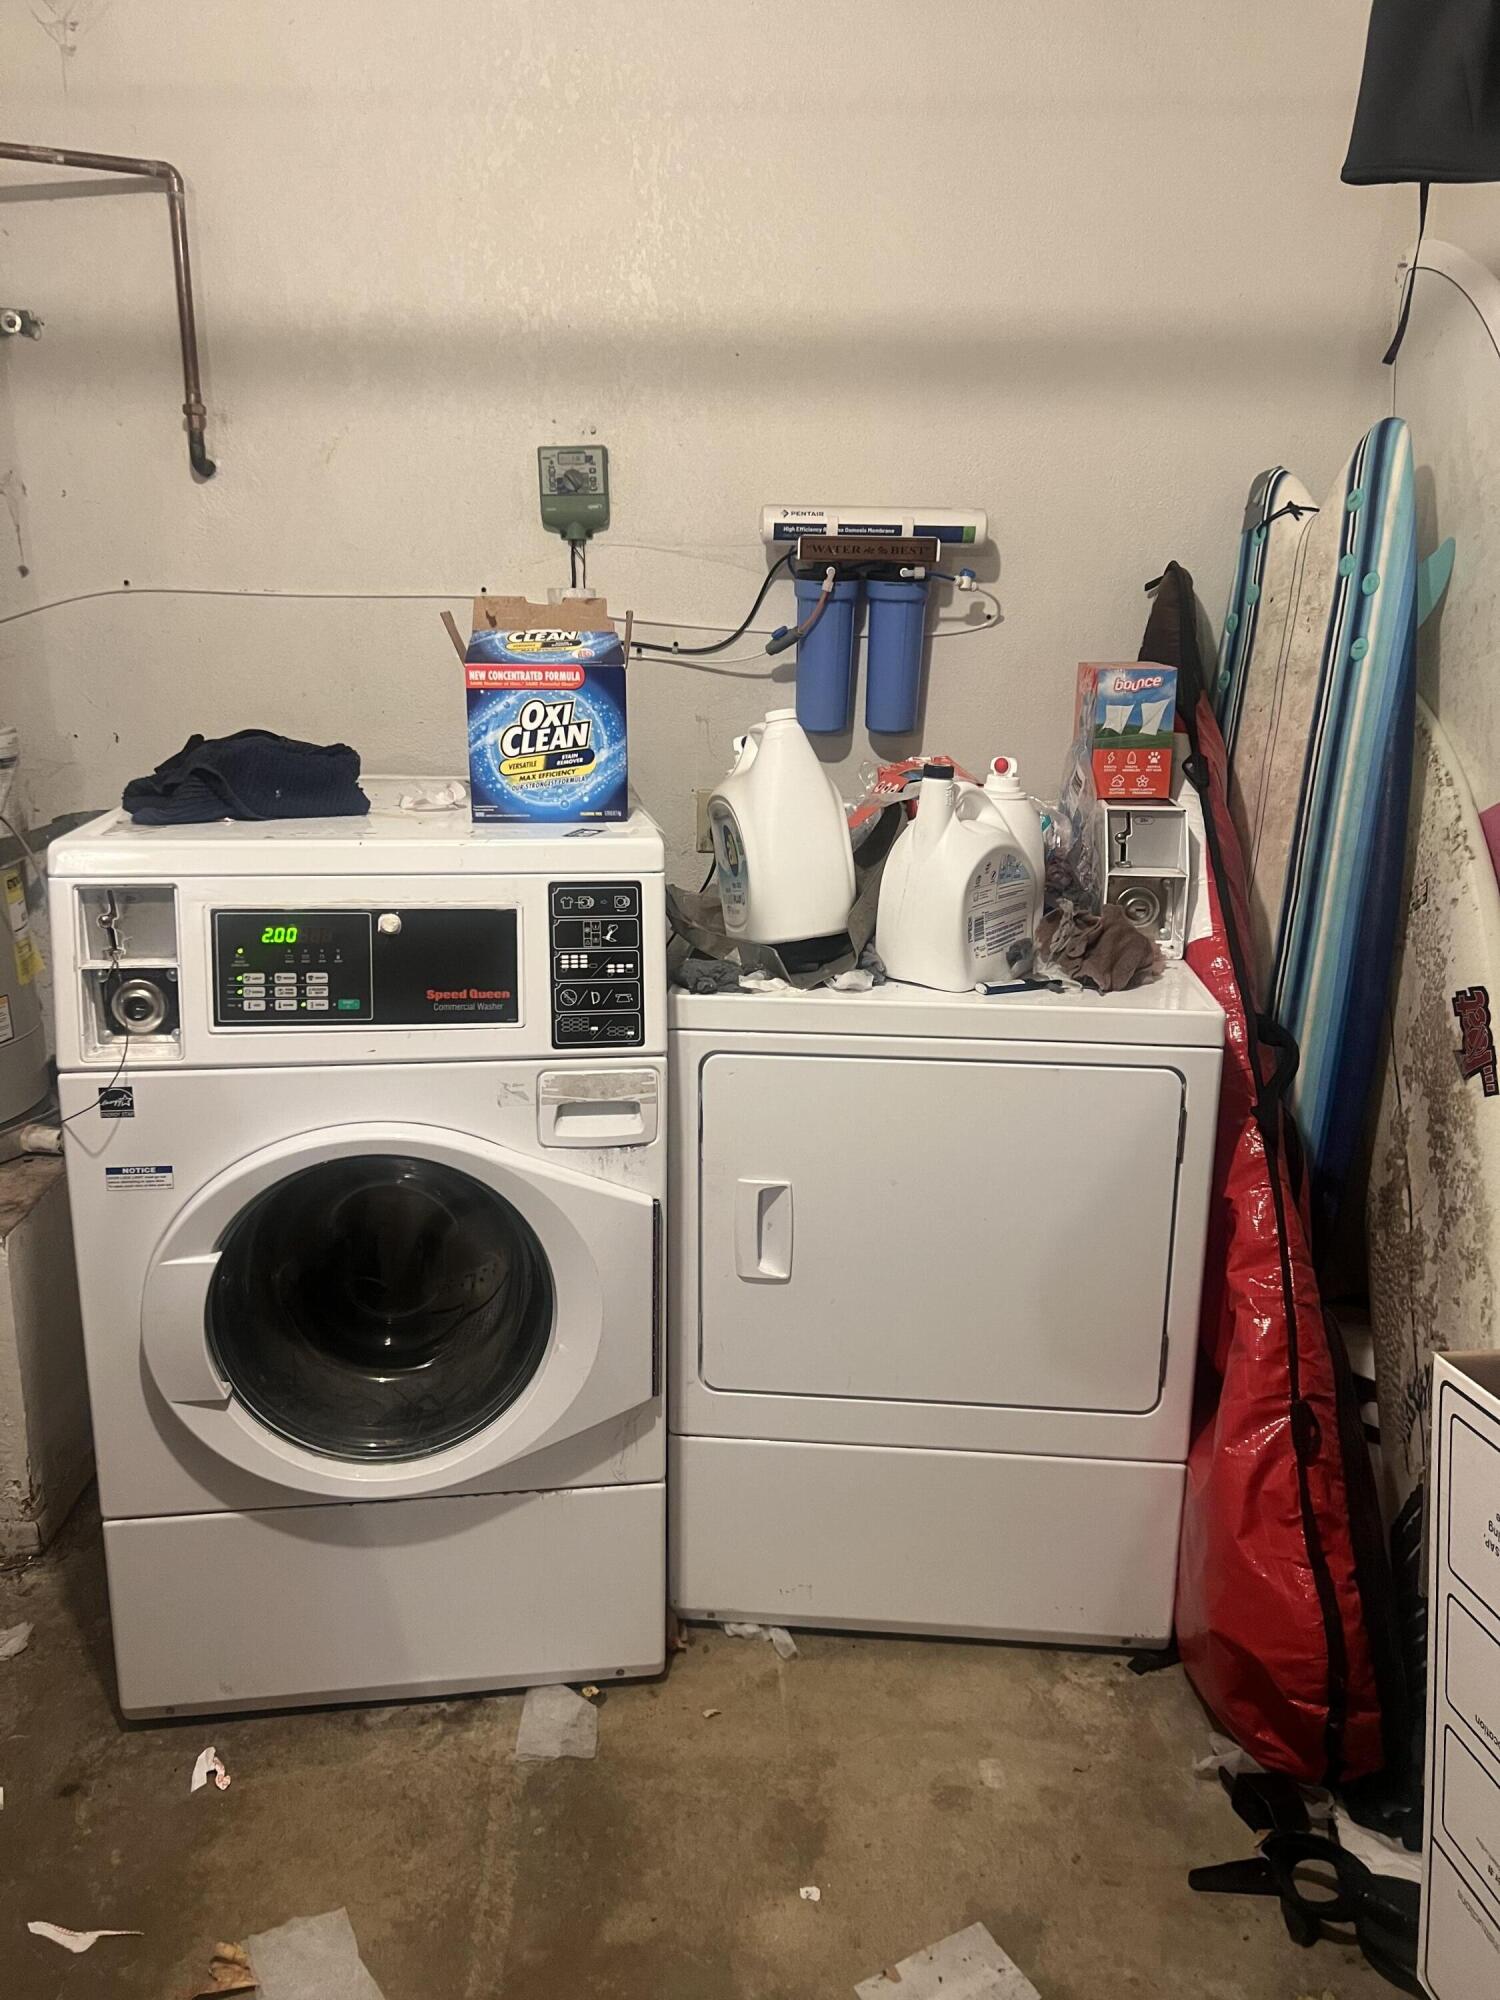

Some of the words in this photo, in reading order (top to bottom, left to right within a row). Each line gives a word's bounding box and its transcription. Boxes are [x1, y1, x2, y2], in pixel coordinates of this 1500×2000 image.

[783, 526, 795, 534] High
[796, 526, 822, 534] Efficiency
[509, 631, 577, 643] CLEAN
[469, 671, 486, 681] NEW
[488, 671, 543, 681] CONCENTRATED
[545, 671, 580, 681] FORMULA
[1114, 675, 1162, 691] bounce
[520, 699, 574, 731] OXI
[501, 722, 590, 758] CLEAN
[556, 757, 584, 766] REMOVER
[561, 752, 579, 760] STAIN
[508, 760, 537, 771] VERSATILE
[519, 774, 537, 782] MAX
[538, 768, 577, 779] EFFICIENCY
[511, 783, 524, 791] OUR
[526, 780, 556, 790] STRONGEST
[557, 776, 586, 785] FORMULA
[262, 927, 298, 943] 2.00
[426, 989, 468, 1001] Speed
[469, 988, 511, 999] Queen
[433, 1002, 475, 1011] Commercial
[477, 1002, 503, 1011] Washer
[122, 1166, 156, 1174] NOTICE
